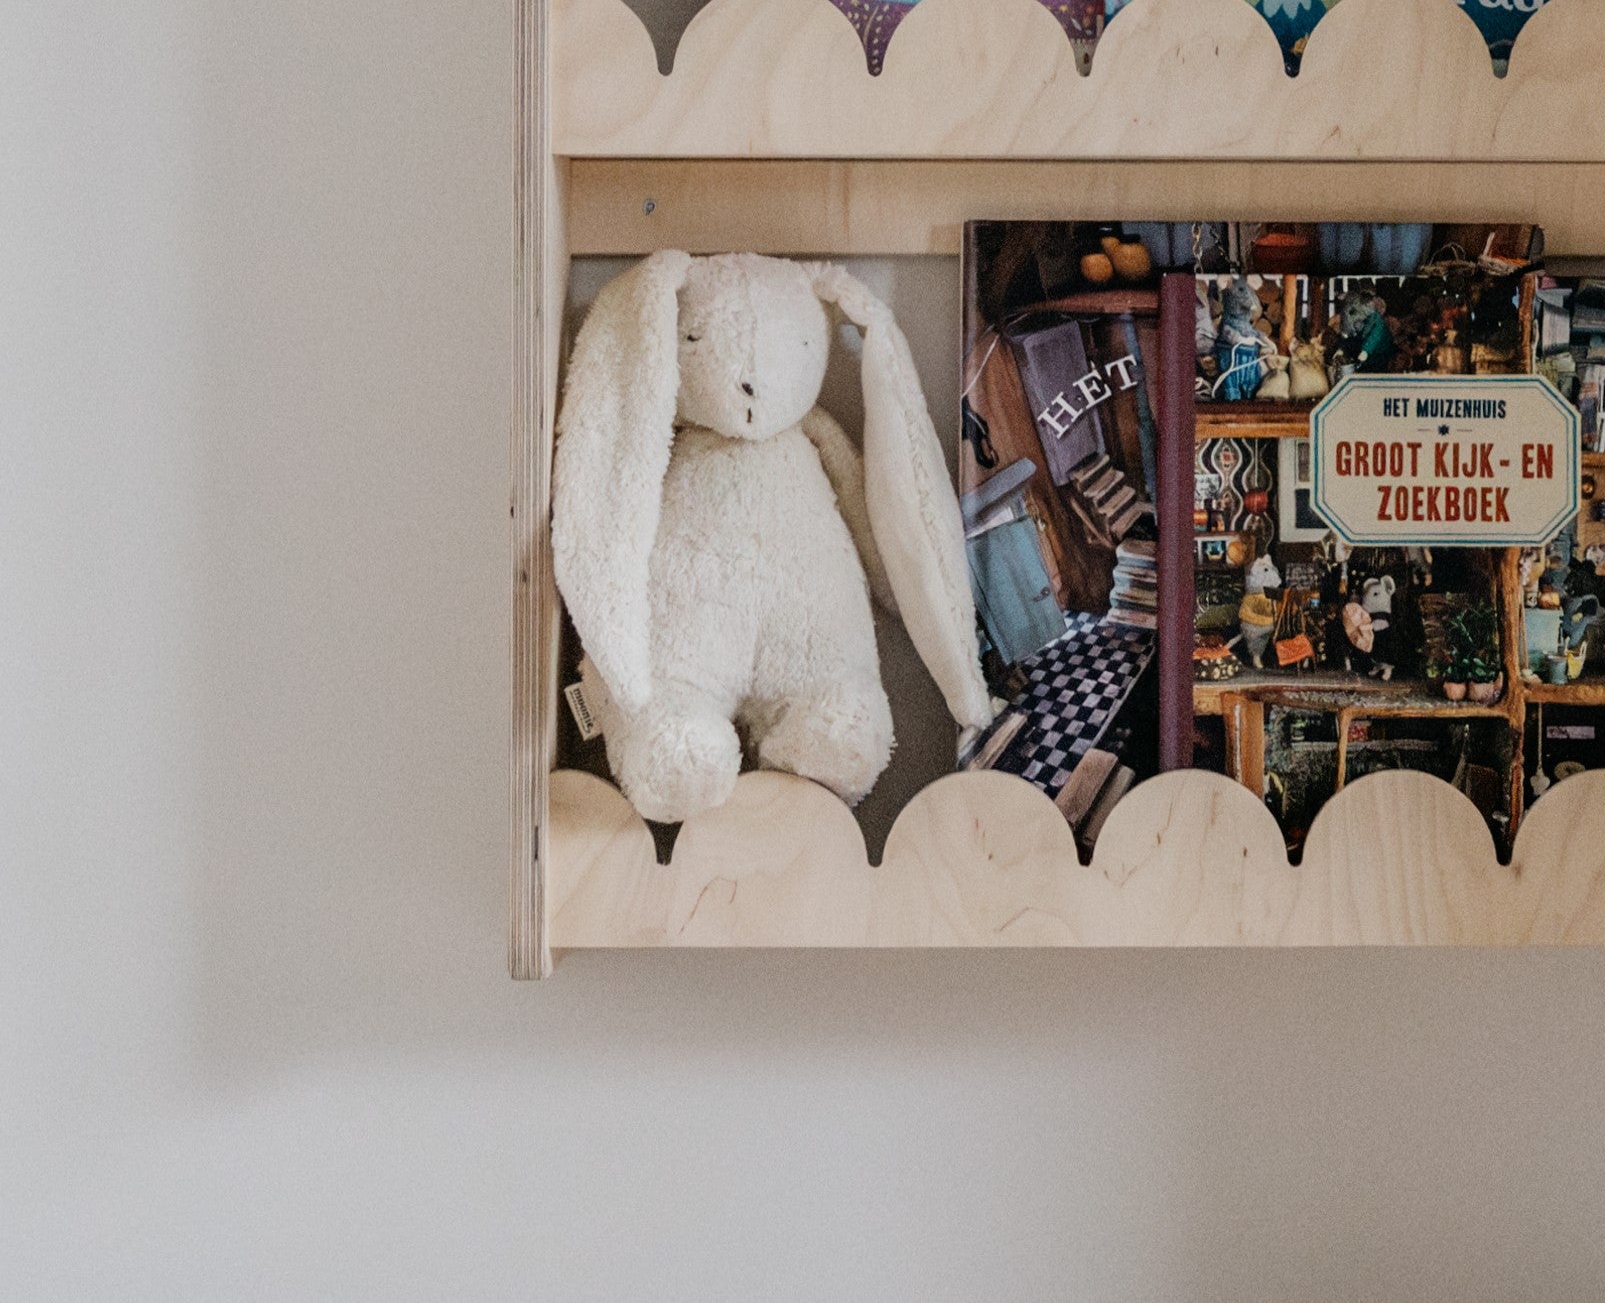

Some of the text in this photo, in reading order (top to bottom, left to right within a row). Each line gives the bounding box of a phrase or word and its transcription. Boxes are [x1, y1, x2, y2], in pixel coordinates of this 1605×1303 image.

[1037, 354, 1139, 440] HET
[1383, 397, 1507, 419] HET MUIZENHUIS
[1335, 441, 1422, 477] GROOT
[1521, 443, 1554, 479] EN
[1376, 485, 1511, 523] ZOEKBOEK
